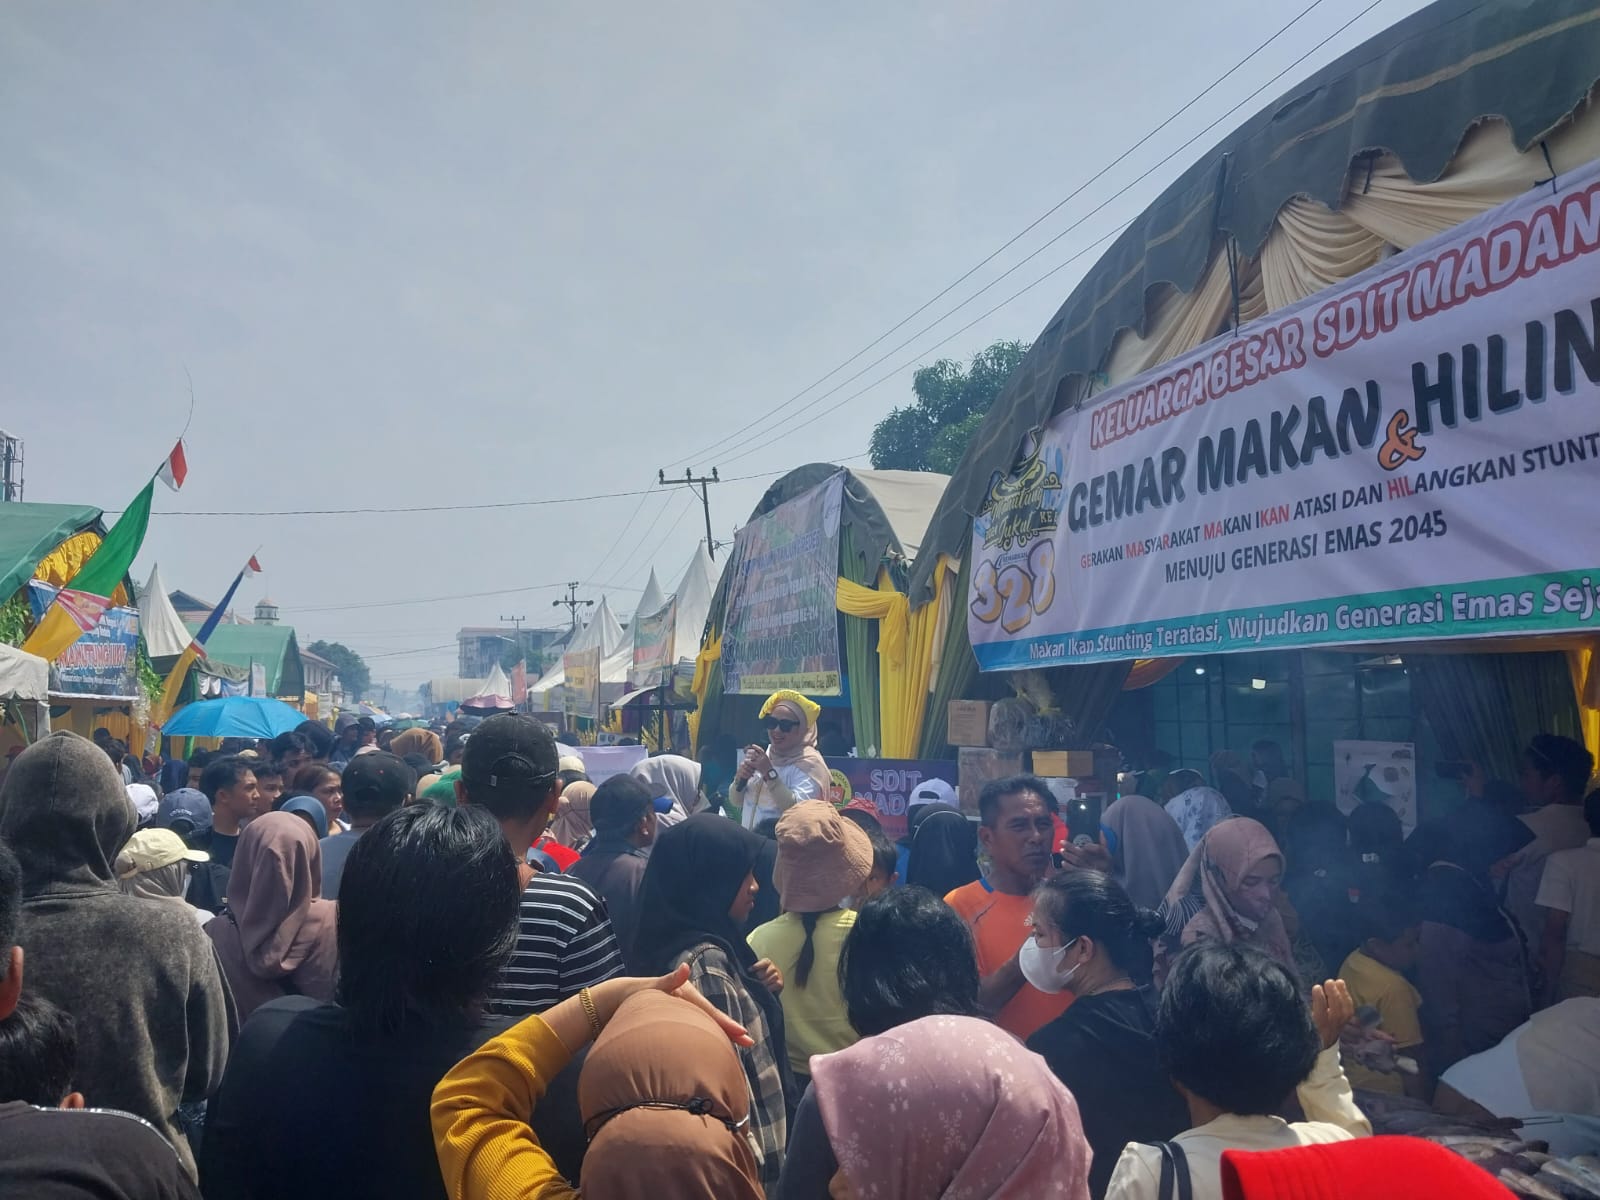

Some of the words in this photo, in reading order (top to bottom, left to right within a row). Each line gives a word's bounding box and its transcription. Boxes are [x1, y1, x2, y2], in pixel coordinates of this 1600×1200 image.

[1090, 363, 1206, 450] KELUARGA
[1207, 317, 1306, 400] BESAR
[1312, 270, 1411, 358] SDIT
[1407, 181, 1600, 321] MADAN
[1068, 446, 1186, 532] GEMAR
[1197, 379, 1382, 495] MAKAN
[1378, 409, 1426, 471] &
[1411, 297, 1600, 436] HILIN
[1080, 545, 1123, 569] GERAKAN
[1126, 525, 1200, 559] MASYARAKAT
[1204, 513, 1251, 541] MAKAN
[1255, 504, 1290, 529] IKAN
[1293, 492, 1337, 521] ATASI
[1342, 482, 1383, 510] DAN
[1387, 454, 1516, 501] HILANGKAN
[1522, 432, 1600, 474] STUNT
[1165, 551, 1226, 583] MENUJU
[1231, 533, 1318, 572] GENERASI
[1324, 521, 1383, 555] EMAS
[1388, 510, 1448, 545] 2045
[1029, 641, 1065, 660] Makan
[1068, 638, 1094, 656] Ikan
[1096, 630, 1153, 652] Stunting
[1156, 619, 1223, 647] Teratasi,
[1227, 609, 1329, 643] Wujudkan
[1335, 592, 1444, 631] Generasi
[1451, 590, 1534, 622] Emas
[870, 768, 922, 792] SDIT
